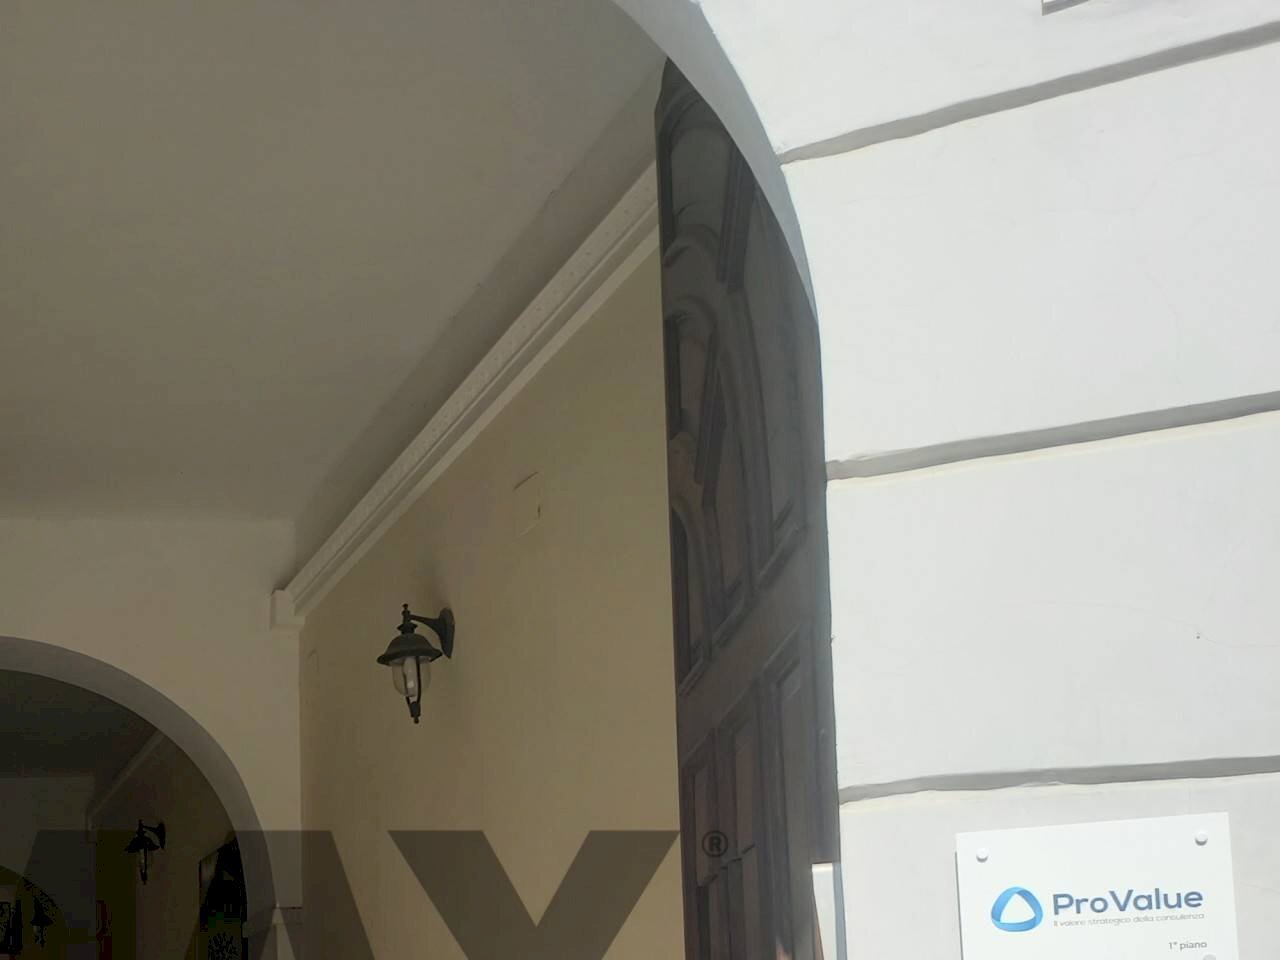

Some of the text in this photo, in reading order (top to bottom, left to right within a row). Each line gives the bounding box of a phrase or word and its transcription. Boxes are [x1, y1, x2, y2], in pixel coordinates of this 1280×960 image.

[1052, 888, 1204, 916] ProValue
[1059, 918, 1087, 927] valore
[1088, 917, 1131, 927] strategico
[1179, 941, 1208, 951] piano
